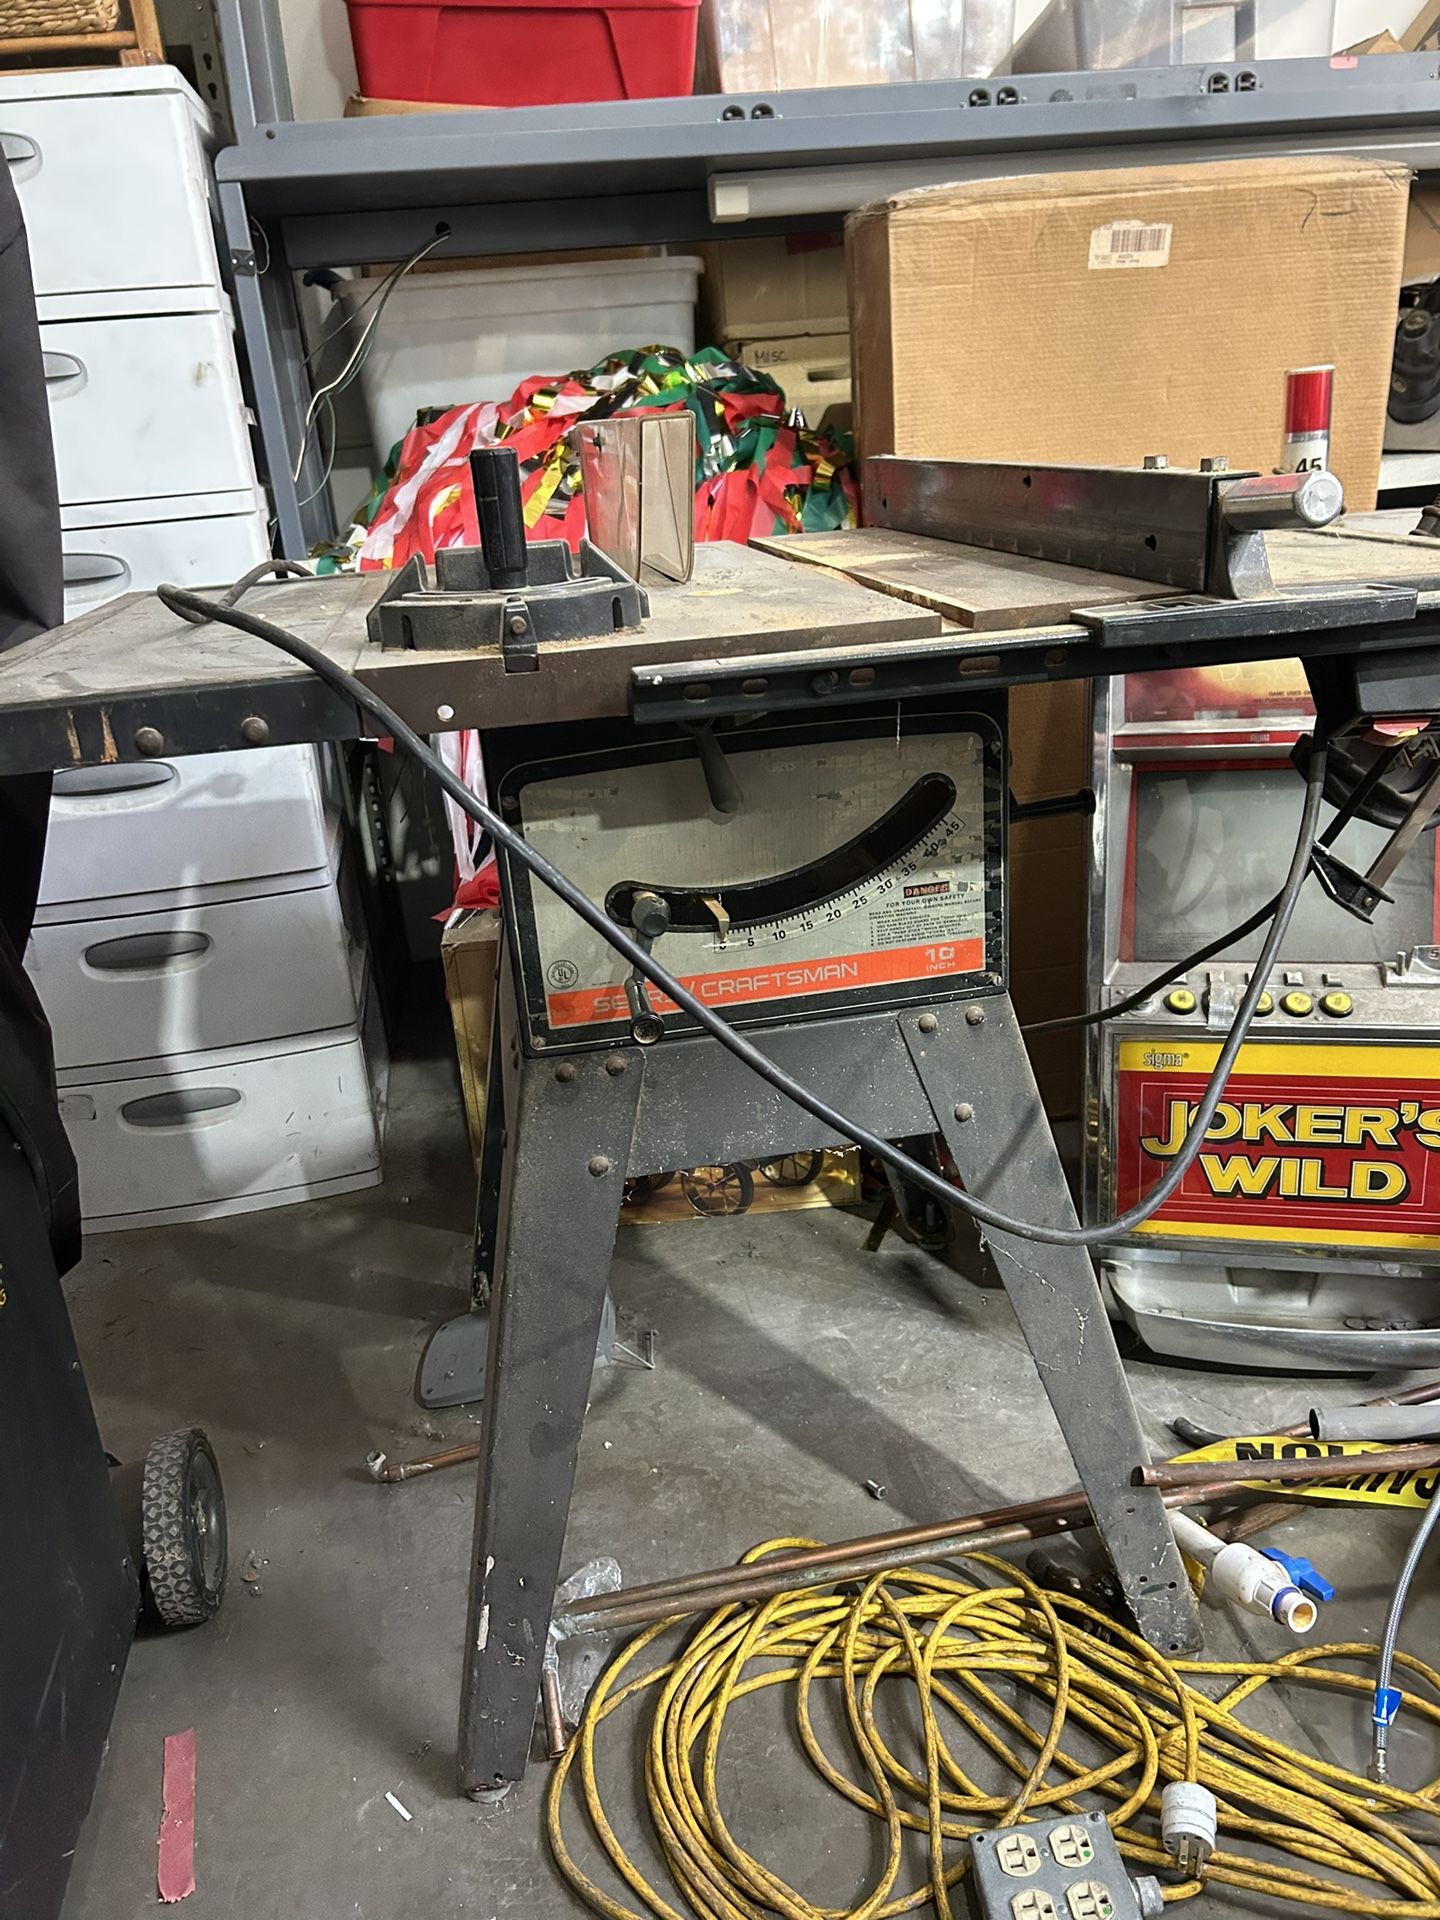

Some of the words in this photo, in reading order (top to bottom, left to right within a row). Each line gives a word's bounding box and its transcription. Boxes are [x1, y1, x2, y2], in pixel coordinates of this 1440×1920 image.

[748, 938, 754, 946] 5
[772, 930, 786, 941] 10
[800, 921, 814, 932] 15
[826, 909, 841, 922] 20
[852, 896, 868, 909] 25
[877, 879, 893, 894] 30
[901, 861, 917, 876] 35
[945, 821, 960, 838] 45
[925, 946, 954, 963] 10
[926, 962, 955, 972] INCH
[592, 986, 680, 1012] SER
[700, 962, 858, 998] CRAFTSMAN
[1140, 1100, 1440, 1157] JOKER'S
[1199, 1154, 1408, 1202] WILD
